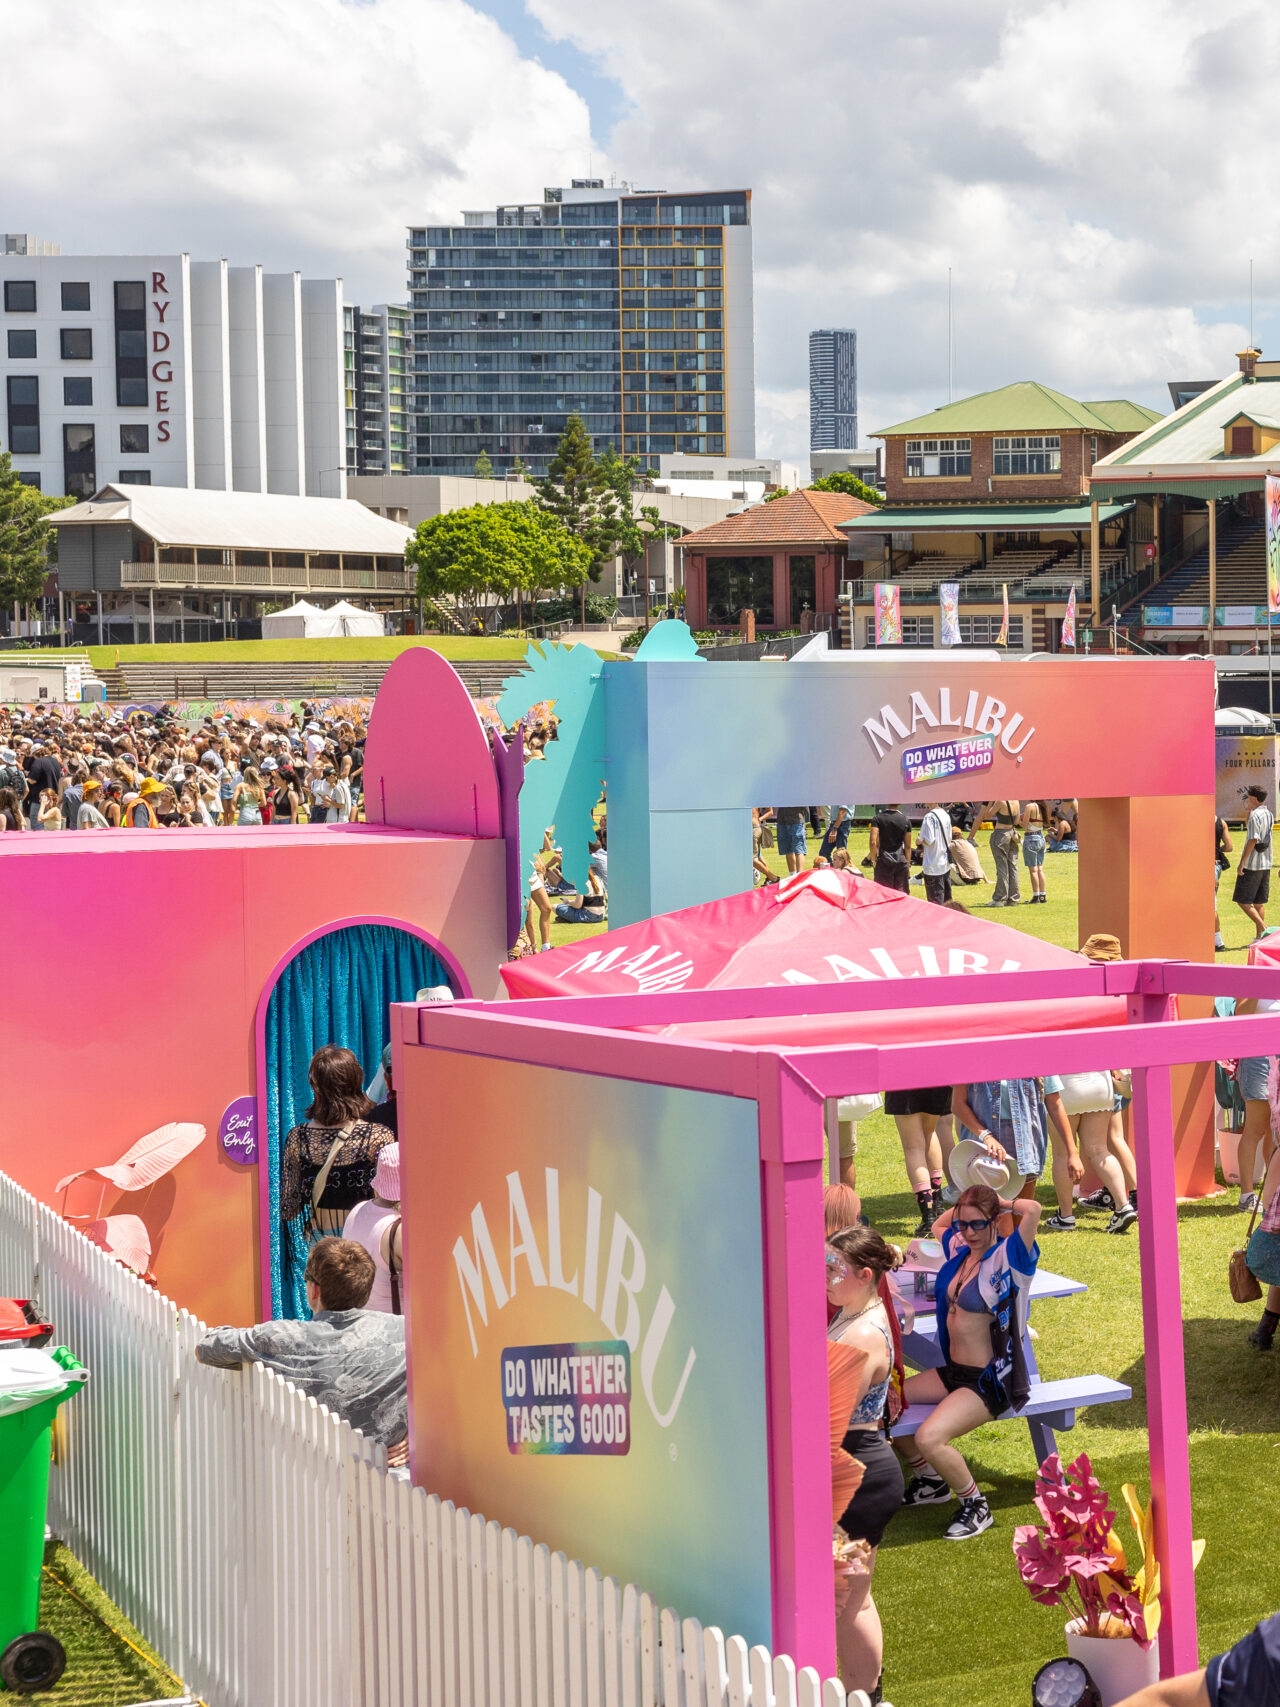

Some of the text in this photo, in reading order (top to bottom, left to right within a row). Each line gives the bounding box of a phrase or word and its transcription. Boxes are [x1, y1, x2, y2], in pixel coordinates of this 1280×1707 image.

[152, 272, 173, 442] RYDGES
[862, 688, 1035, 758] MALIBU
[906, 738, 992, 766] DO WHATEVER
[908, 752, 992, 780] TASTES GOOD
[1225, 759, 1276, 768] FOUR PILLARS
[555, 945, 695, 993] MALIB
[223, 1131, 256, 1155] Only
[227, 1114, 253, 1131] Exit
[452, 1167, 697, 1428] MALIBU
[505, 1354, 627, 1397] DO WHATEVER
[509, 1403, 627, 1444] TASTES GOOD
